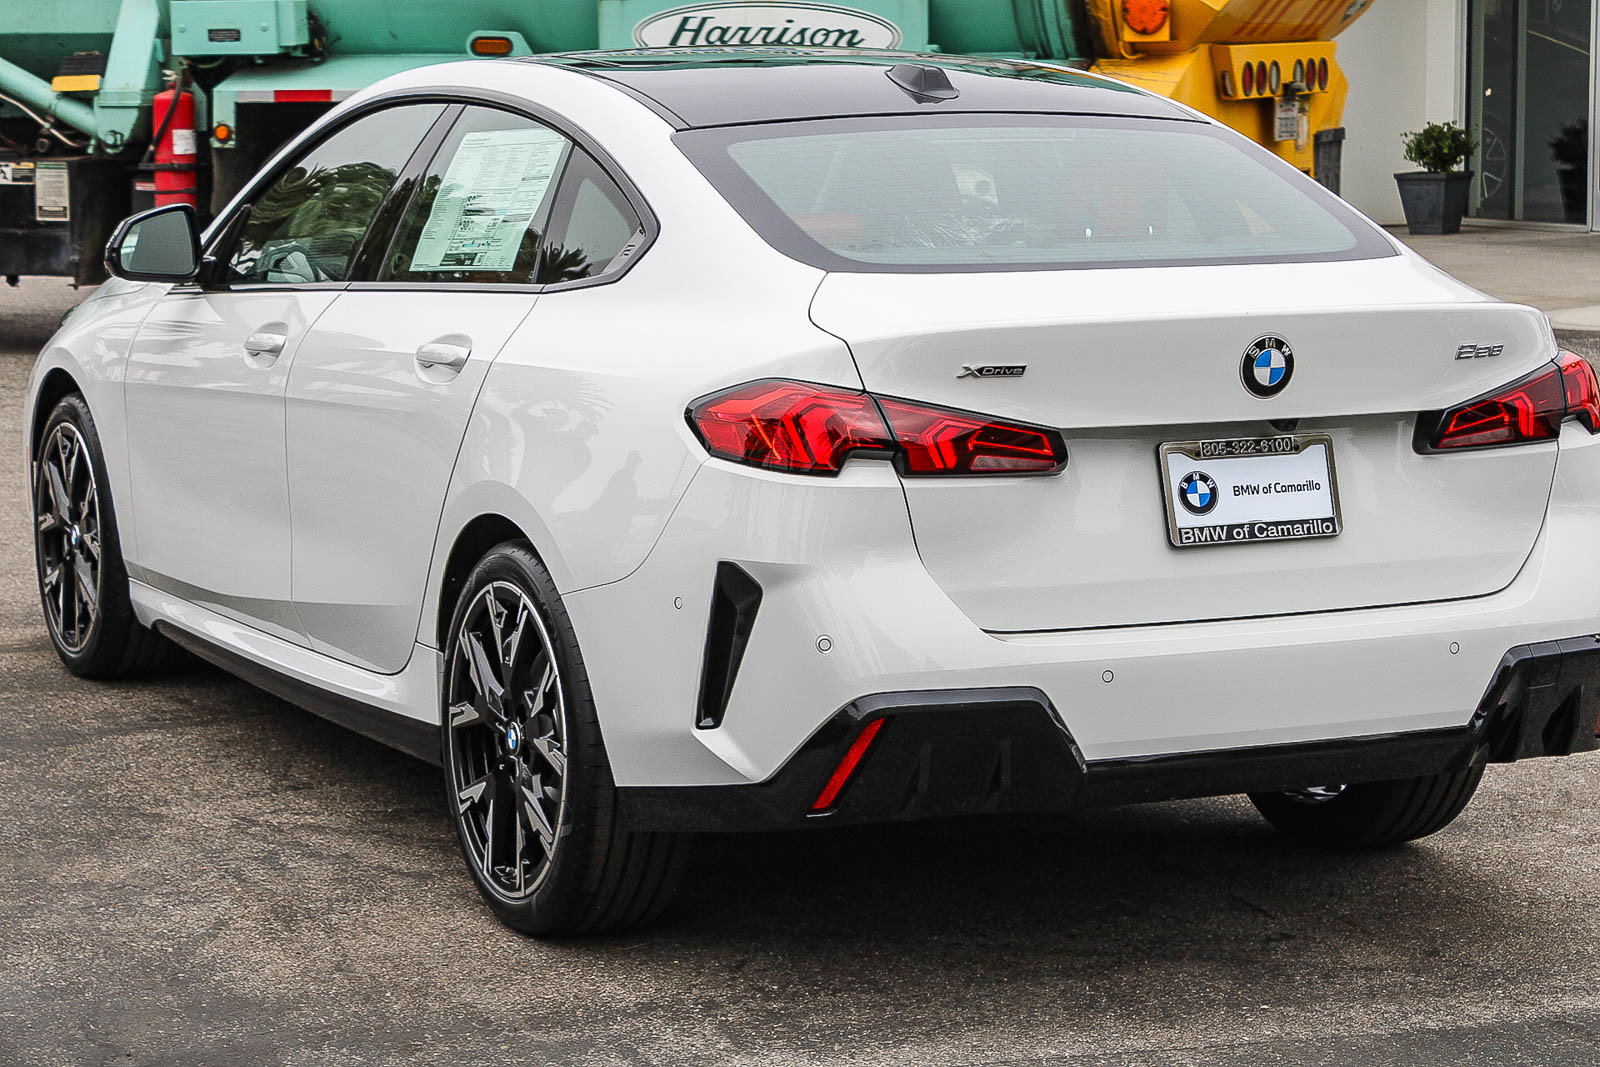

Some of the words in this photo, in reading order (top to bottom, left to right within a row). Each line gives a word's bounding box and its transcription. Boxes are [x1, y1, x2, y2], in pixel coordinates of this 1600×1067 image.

[669, 16, 865, 47] Harrison
[1248, 338, 1292, 359] BMW
[1203, 438, 1291, 456] 805-322-6100
[1181, 473, 1216, 489] BMW
[1233, 484, 1259, 496] BMW
[1262, 484, 1272, 494] of
[1274, 480, 1321, 493] Camarillo
[1181, 529, 1228, 543] BMW
[1233, 526, 1250, 540] of
[1254, 521, 1334, 540] Camarillo
